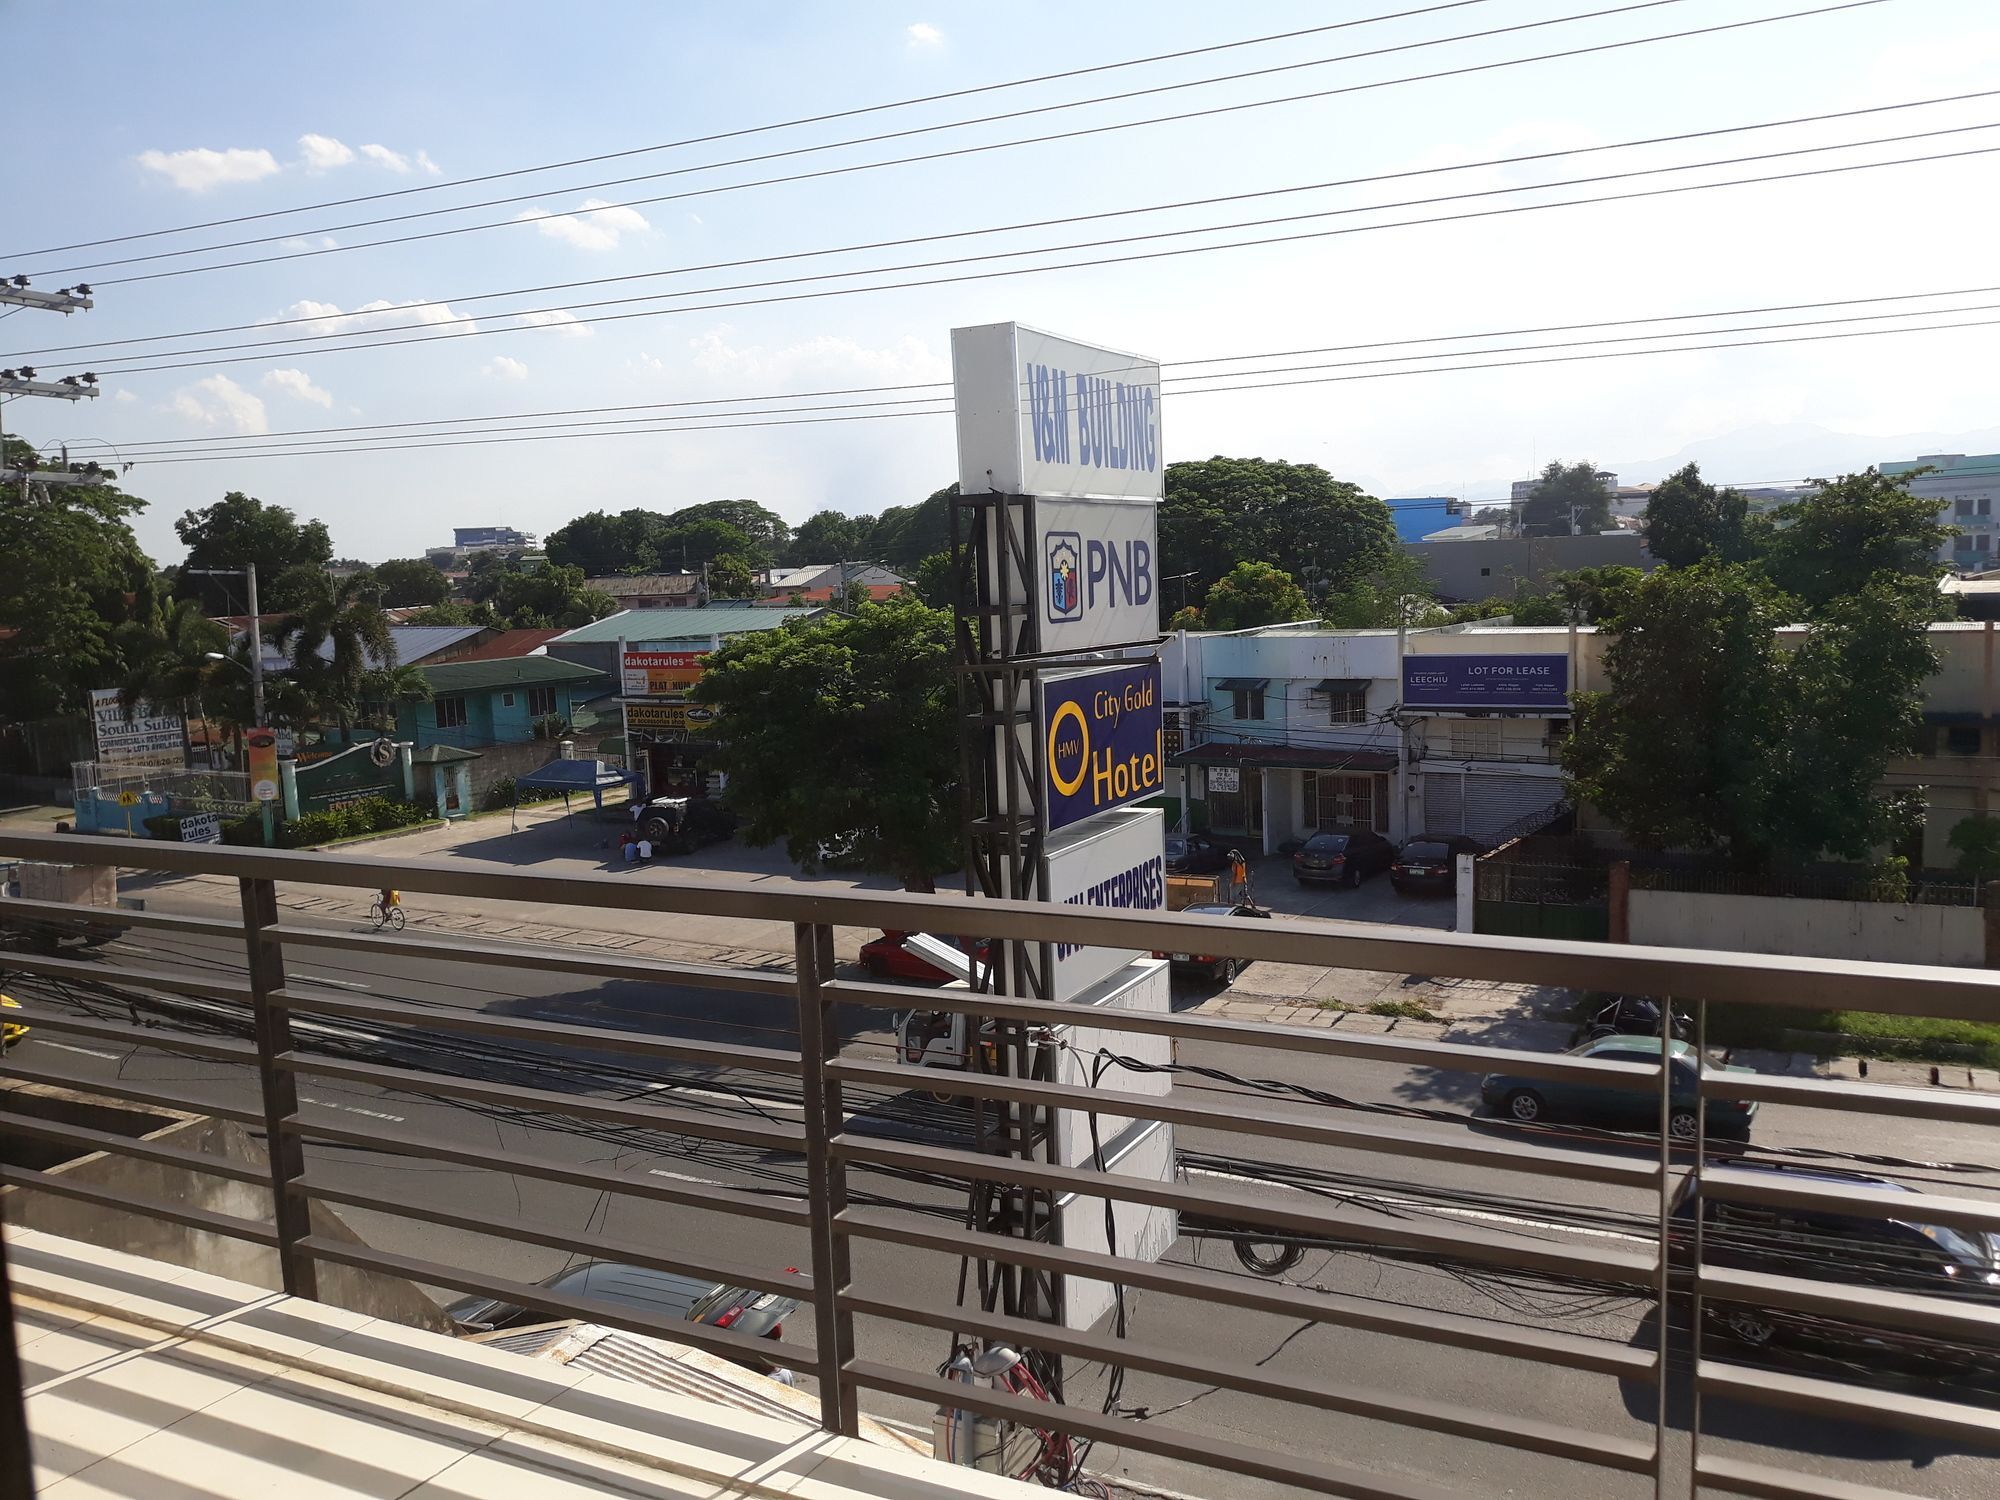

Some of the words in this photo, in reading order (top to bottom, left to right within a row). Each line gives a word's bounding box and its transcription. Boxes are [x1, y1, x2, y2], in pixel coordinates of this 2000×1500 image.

[1027, 363, 1070, 465] V&M
[1076, 373, 1156, 473] BUILDING
[1087, 540, 1152, 610] PNB
[625, 656, 684, 666] dakotarules
[1468, 667, 1489, 675] LOT
[1491, 667, 1513, 675] FOR
[1516, 667, 1550, 675] LEASE
[1094, 690, 1121, 729] City
[1124, 678, 1153, 712] Gold
[627, 707, 685, 719] dakotarules
[98, 721, 139, 737] South
[1058, 739, 1080, 760] HMV
[1092, 728, 1162, 806] Hotel
[181, 813, 218, 830] dakota
[183, 825, 211, 840] rules
